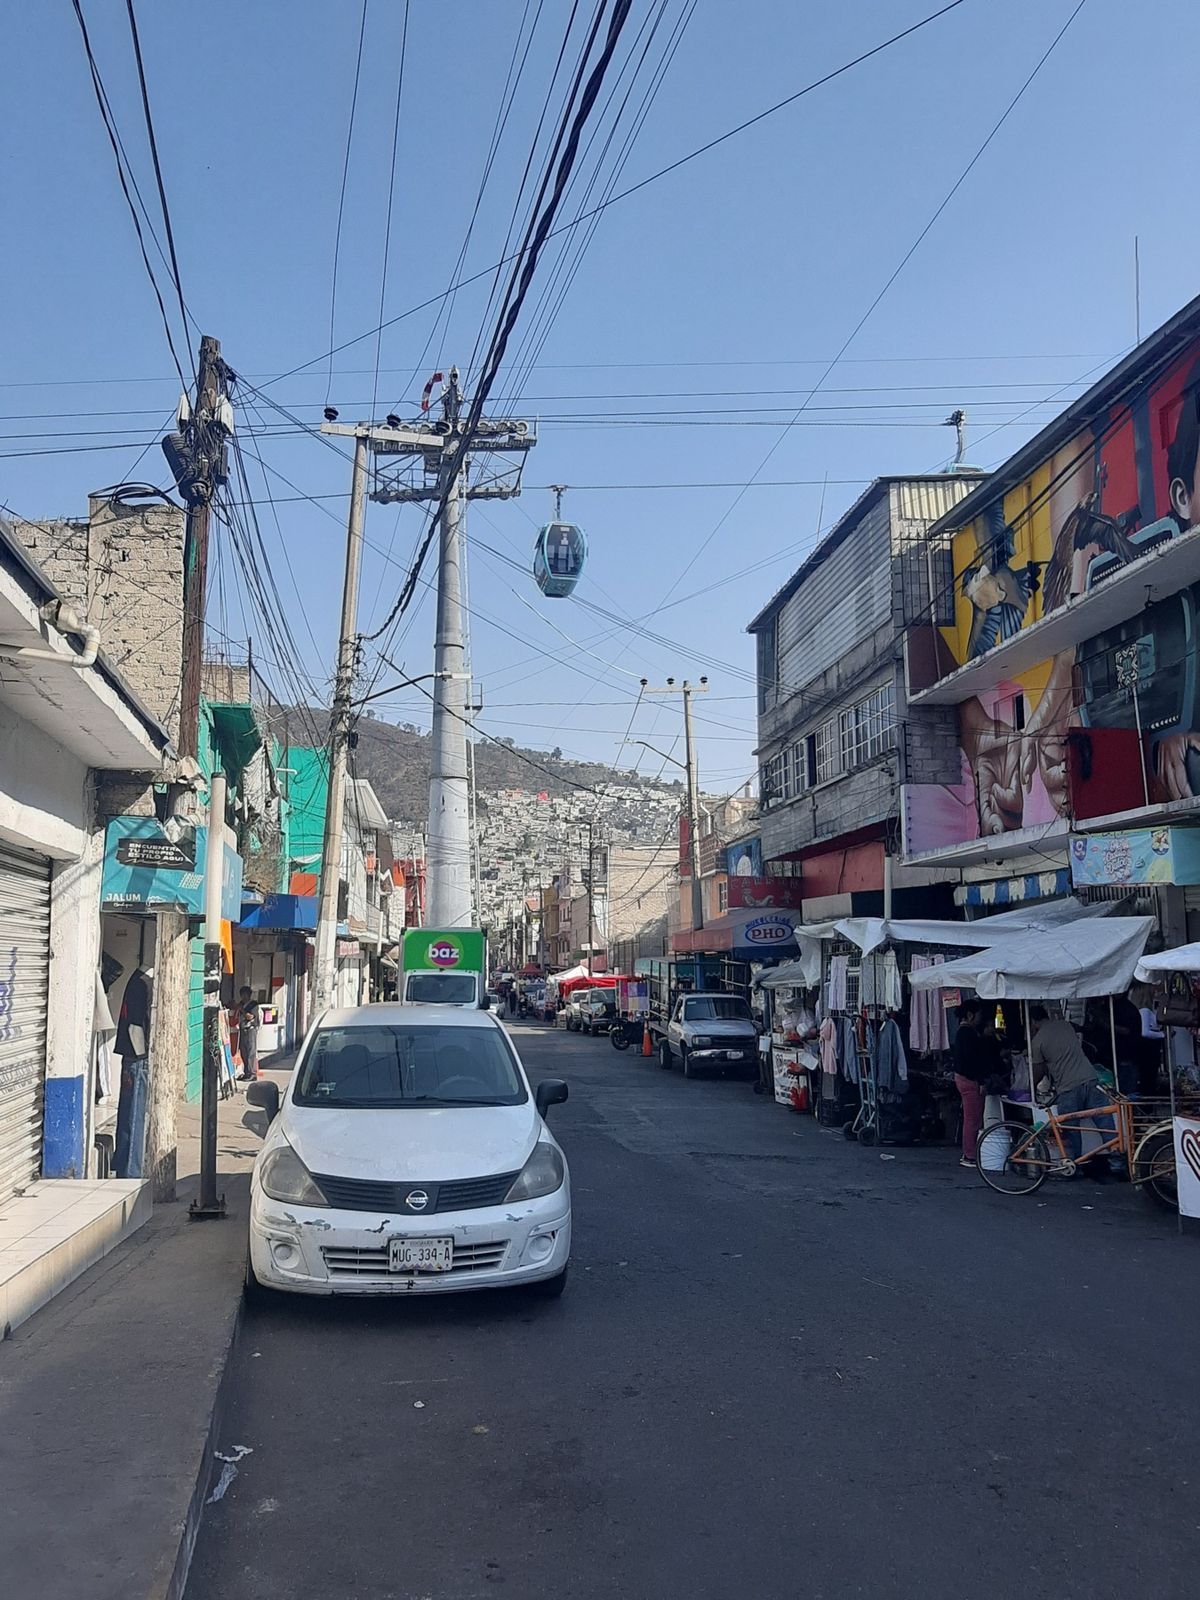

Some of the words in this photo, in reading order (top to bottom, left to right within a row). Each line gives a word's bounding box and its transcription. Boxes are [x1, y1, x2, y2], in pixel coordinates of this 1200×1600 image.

[128, 852, 161, 860] ESTILO
[106, 893, 141, 902] JALUM
[752, 928, 785, 939] PHO
[428, 943, 459, 958] baz
[392, 1247, 450, 1262] MUG-334-A
